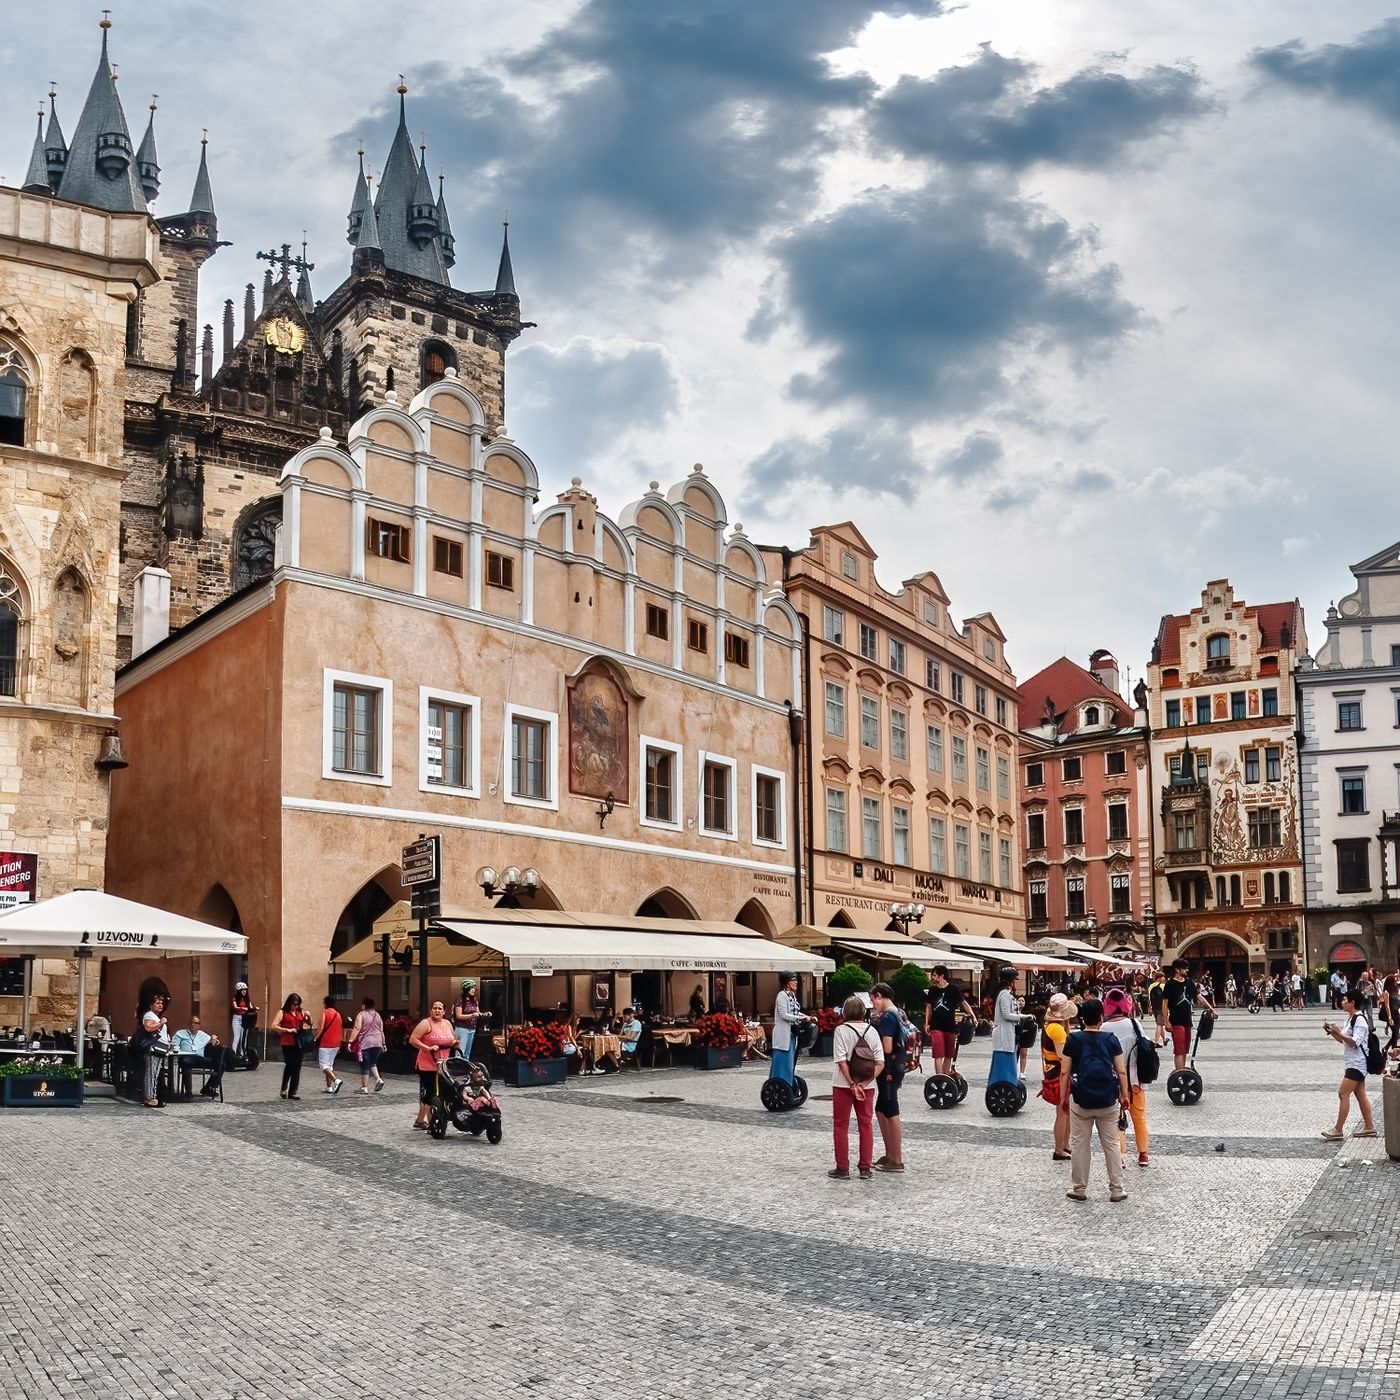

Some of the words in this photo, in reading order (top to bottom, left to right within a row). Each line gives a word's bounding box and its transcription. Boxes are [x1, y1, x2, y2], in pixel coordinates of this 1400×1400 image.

[753, 872, 788, 885] RISTORANTE
[914, 874, 944, 893] MUCHA
[961, 883, 989, 902] WARHOL
[825, 895, 874, 910] RESTAURANT
